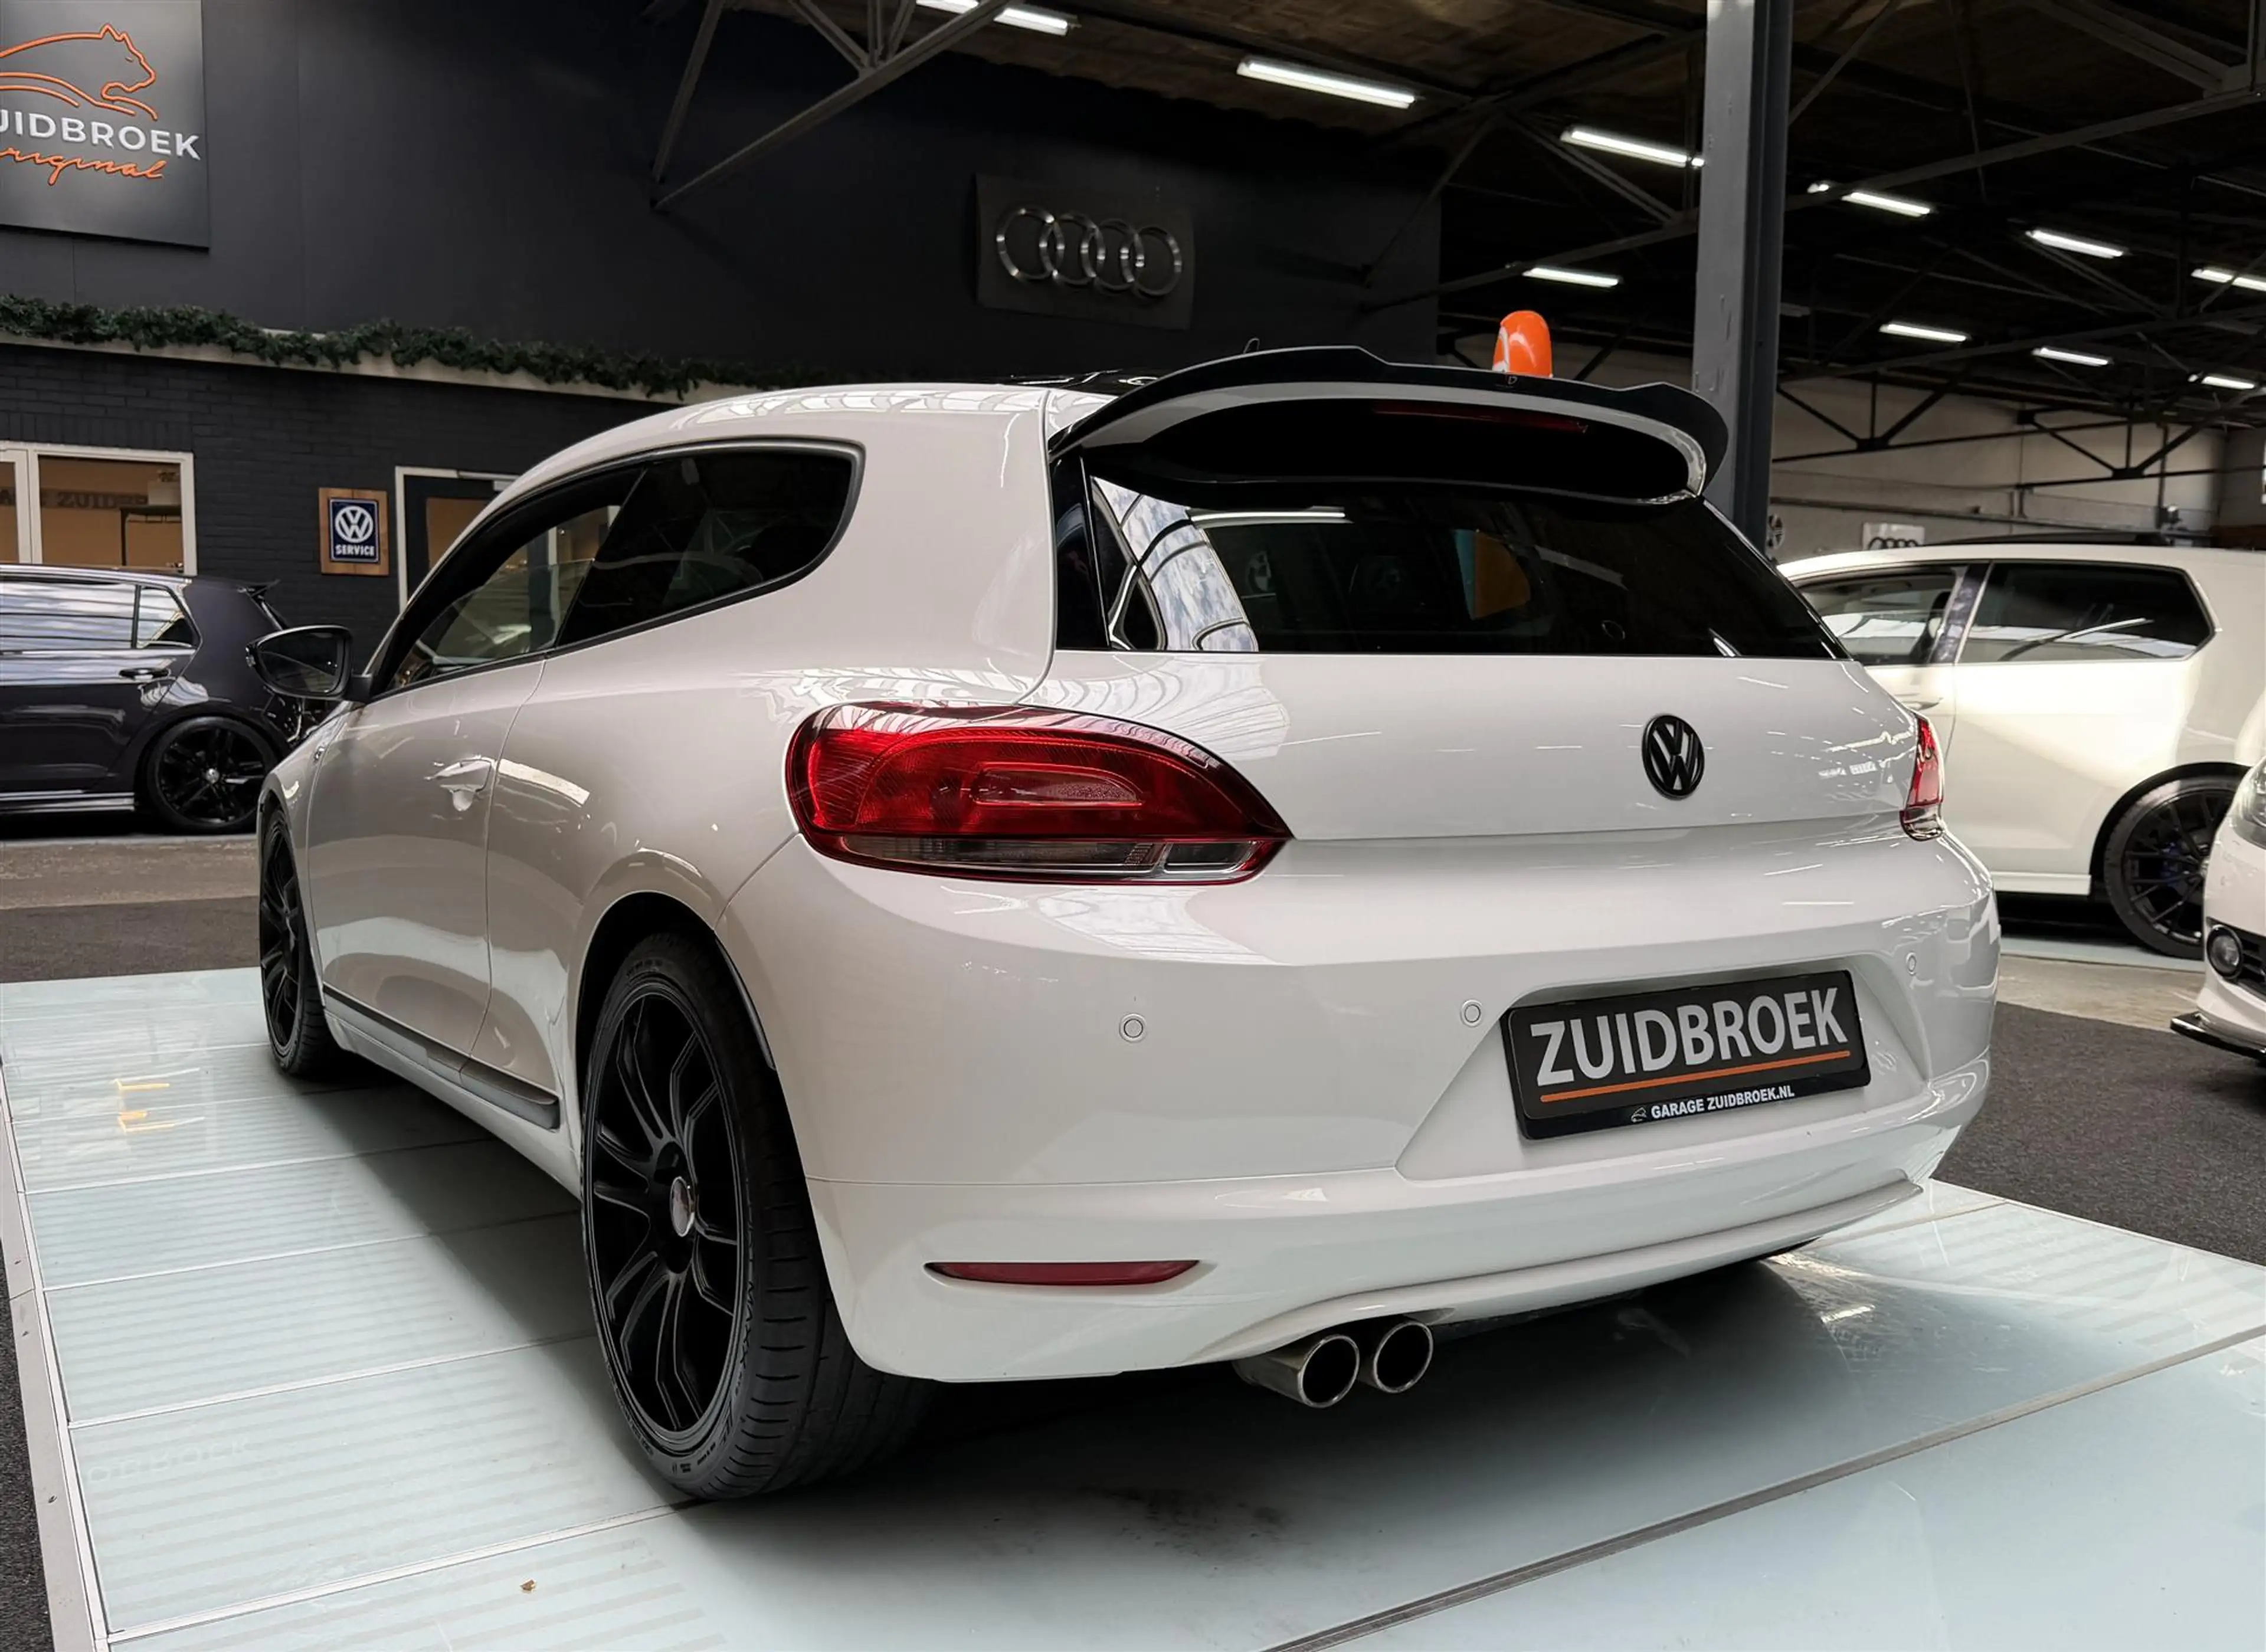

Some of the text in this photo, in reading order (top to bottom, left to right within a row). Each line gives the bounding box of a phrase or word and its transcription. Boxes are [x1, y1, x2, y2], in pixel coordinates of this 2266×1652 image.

[335, 544, 375, 556] SERVICE
[1643, 716, 1704, 799] VW
[1531, 987, 1848, 1087] ZUIDBROEK
[1651, 1085, 1795, 1119] GARAGE ZUIDBROEK.NL
